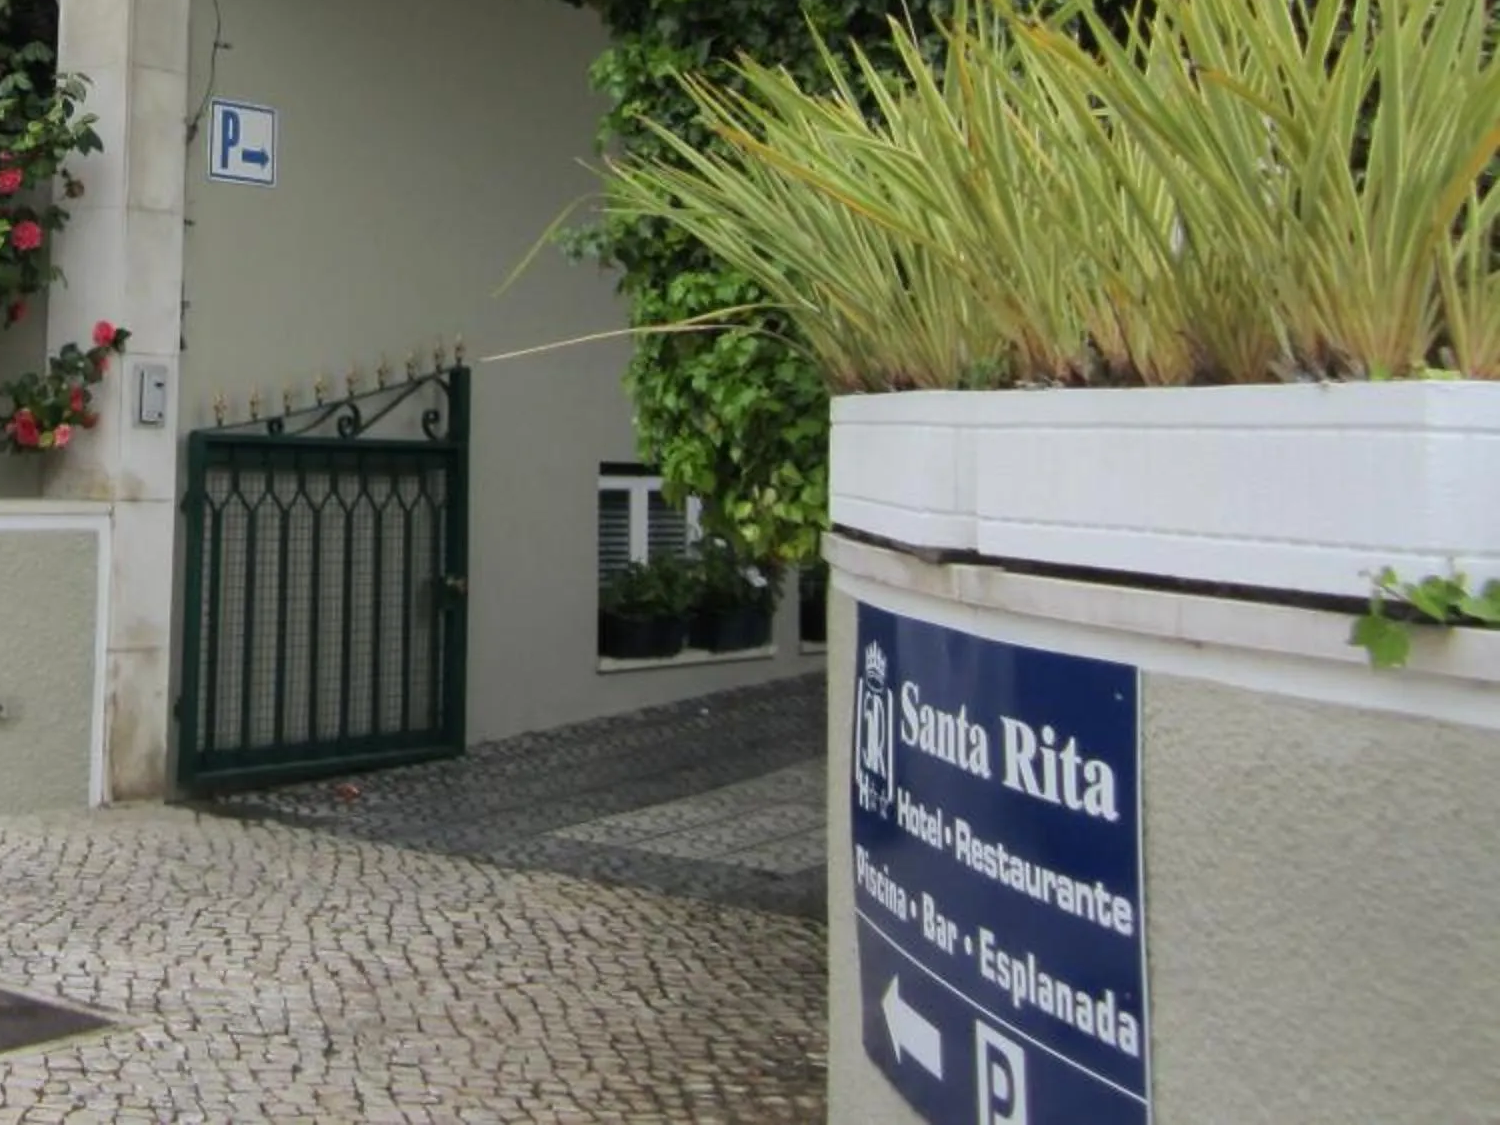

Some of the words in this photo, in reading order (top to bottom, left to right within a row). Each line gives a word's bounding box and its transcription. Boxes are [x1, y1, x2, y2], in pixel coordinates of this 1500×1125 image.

[220, 108, 241, 170] P
[901, 679, 993, 781] Santa
[1001, 715, 1121, 823] Rita
[896, 786, 943, 851] Hotel
[955, 818, 1134, 937] Restaurante
[855, 843, 907, 922] Piscina
[921, 890, 958, 956] Bar
[979, 926, 1140, 1058] Esplanada
[985, 1041, 1016, 1125] P
